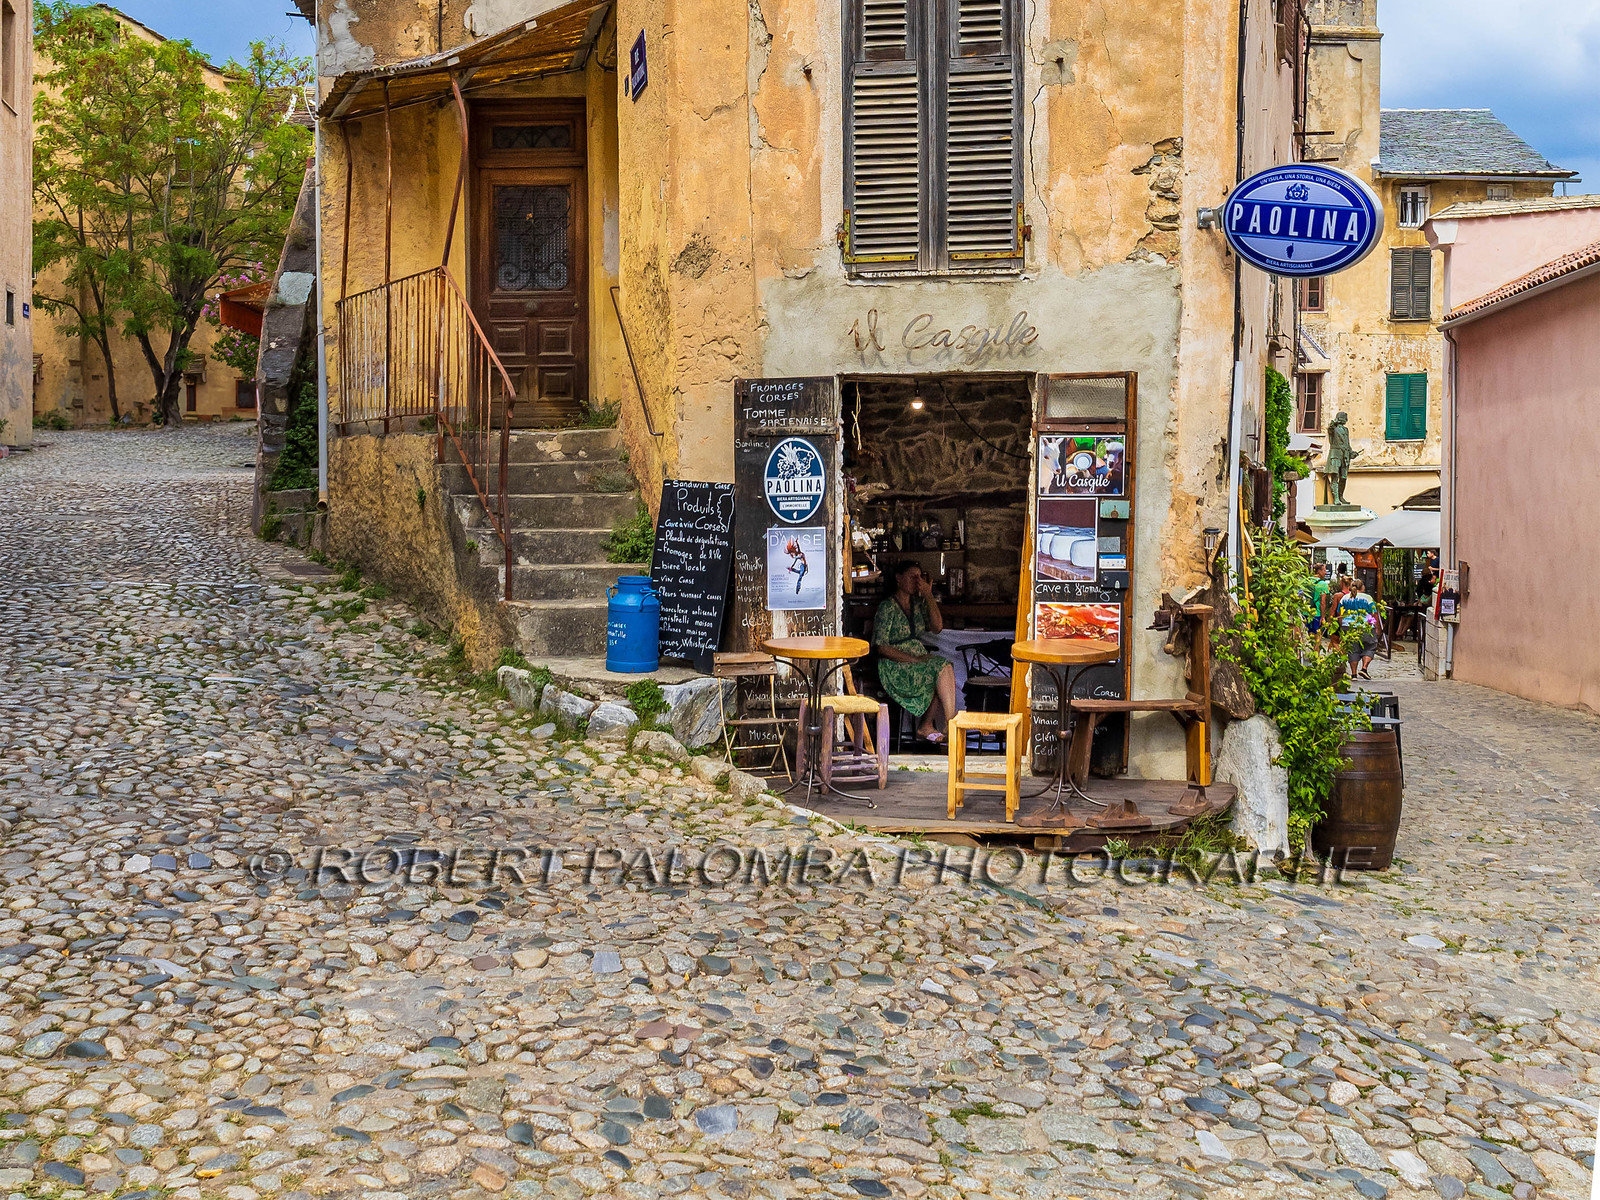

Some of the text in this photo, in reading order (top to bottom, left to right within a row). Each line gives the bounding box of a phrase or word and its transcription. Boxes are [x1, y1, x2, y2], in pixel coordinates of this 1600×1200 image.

[1231, 203, 1359, 242] PAOLINA
[750, 382, 805, 393] FROMAGES
[759, 391, 799, 403] CORSES
[743, 407, 786, 420] TOMME
[672, 480, 709, 489] Sandwich
[767, 479, 822, 494] PAOLINA
[1068, 473, 1111, 493] Casgile
[676, 487, 715, 516] Produits
[694, 515, 727, 534] Corses
[770, 533, 822, 547] DANSE
[735, 549, 749, 560] Gin
[685, 560, 707, 572] locale
[659, 613, 690, 624] anistrelli
